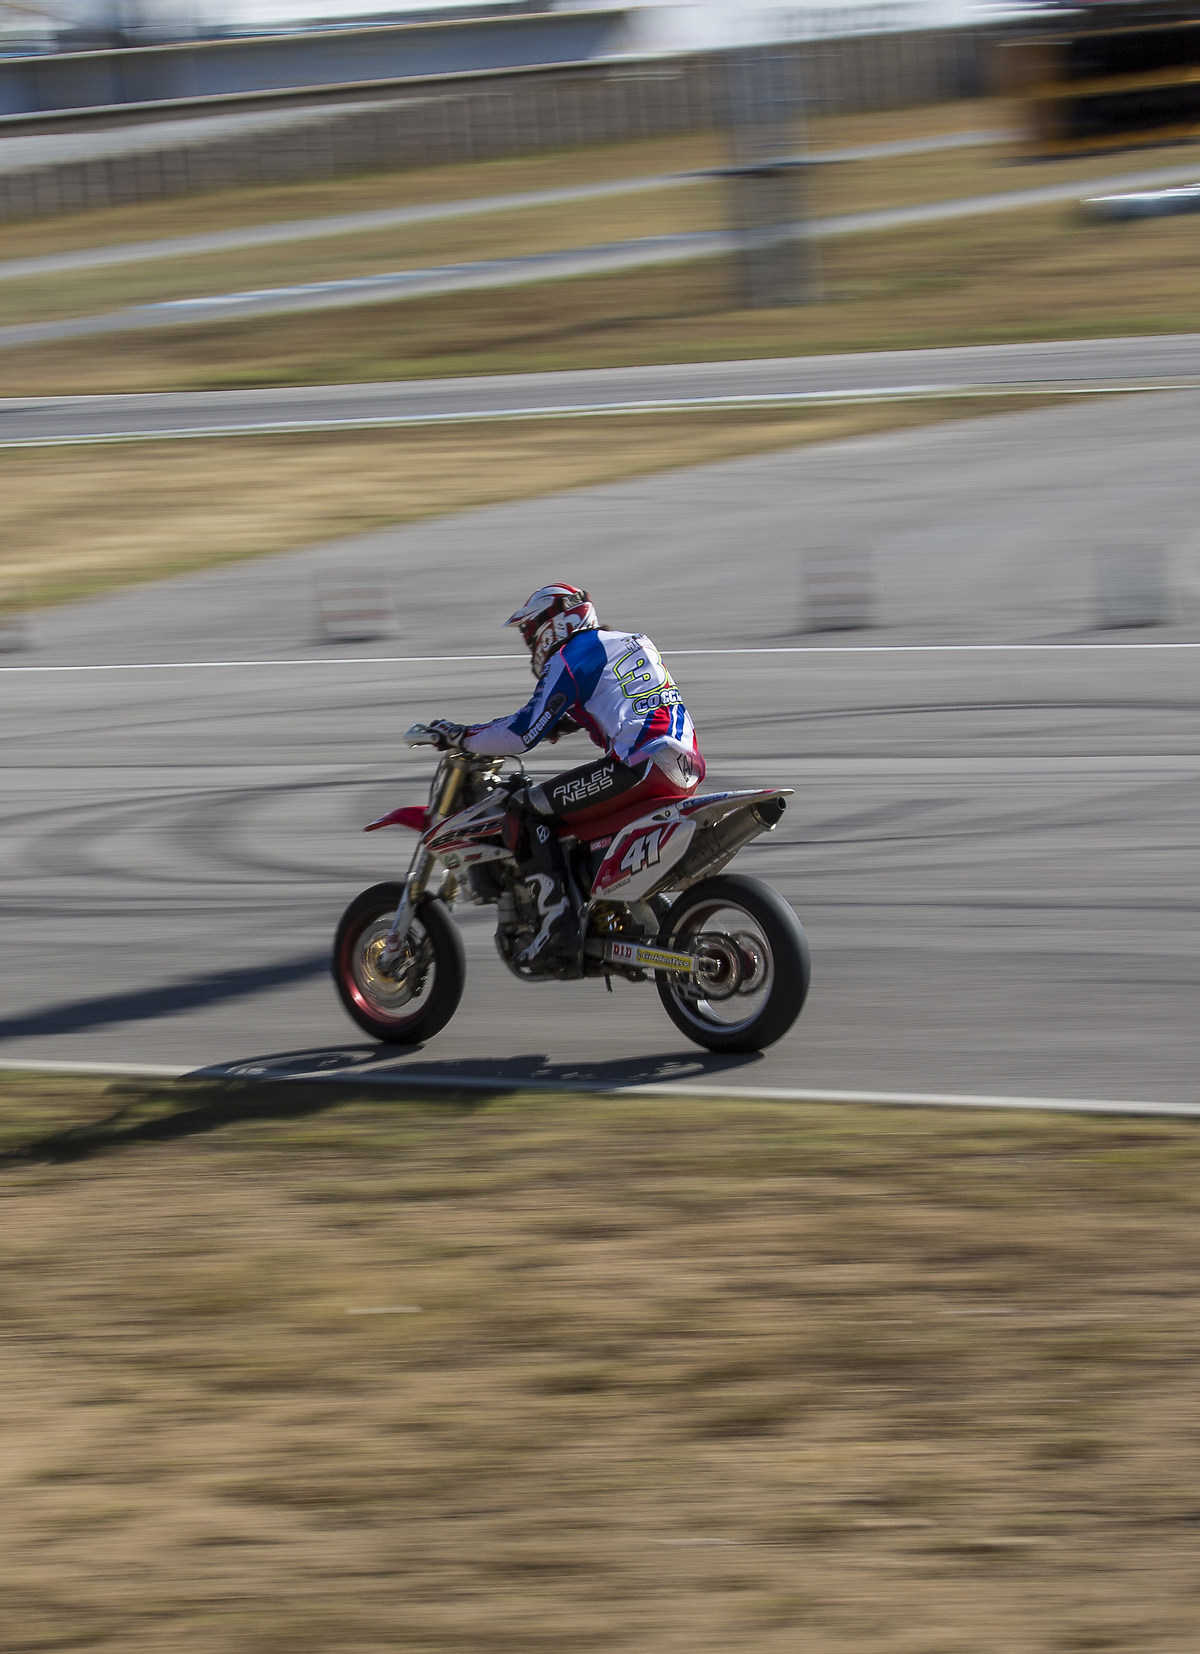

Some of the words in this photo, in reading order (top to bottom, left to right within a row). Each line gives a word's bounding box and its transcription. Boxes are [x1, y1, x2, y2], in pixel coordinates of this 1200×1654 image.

[613, 647, 676, 699] 3
[522, 711, 552, 745] extreme
[553, 763, 614, 798] ARLEN
[562, 775, 614, 806] NESS
[620, 827, 663, 876] 41
